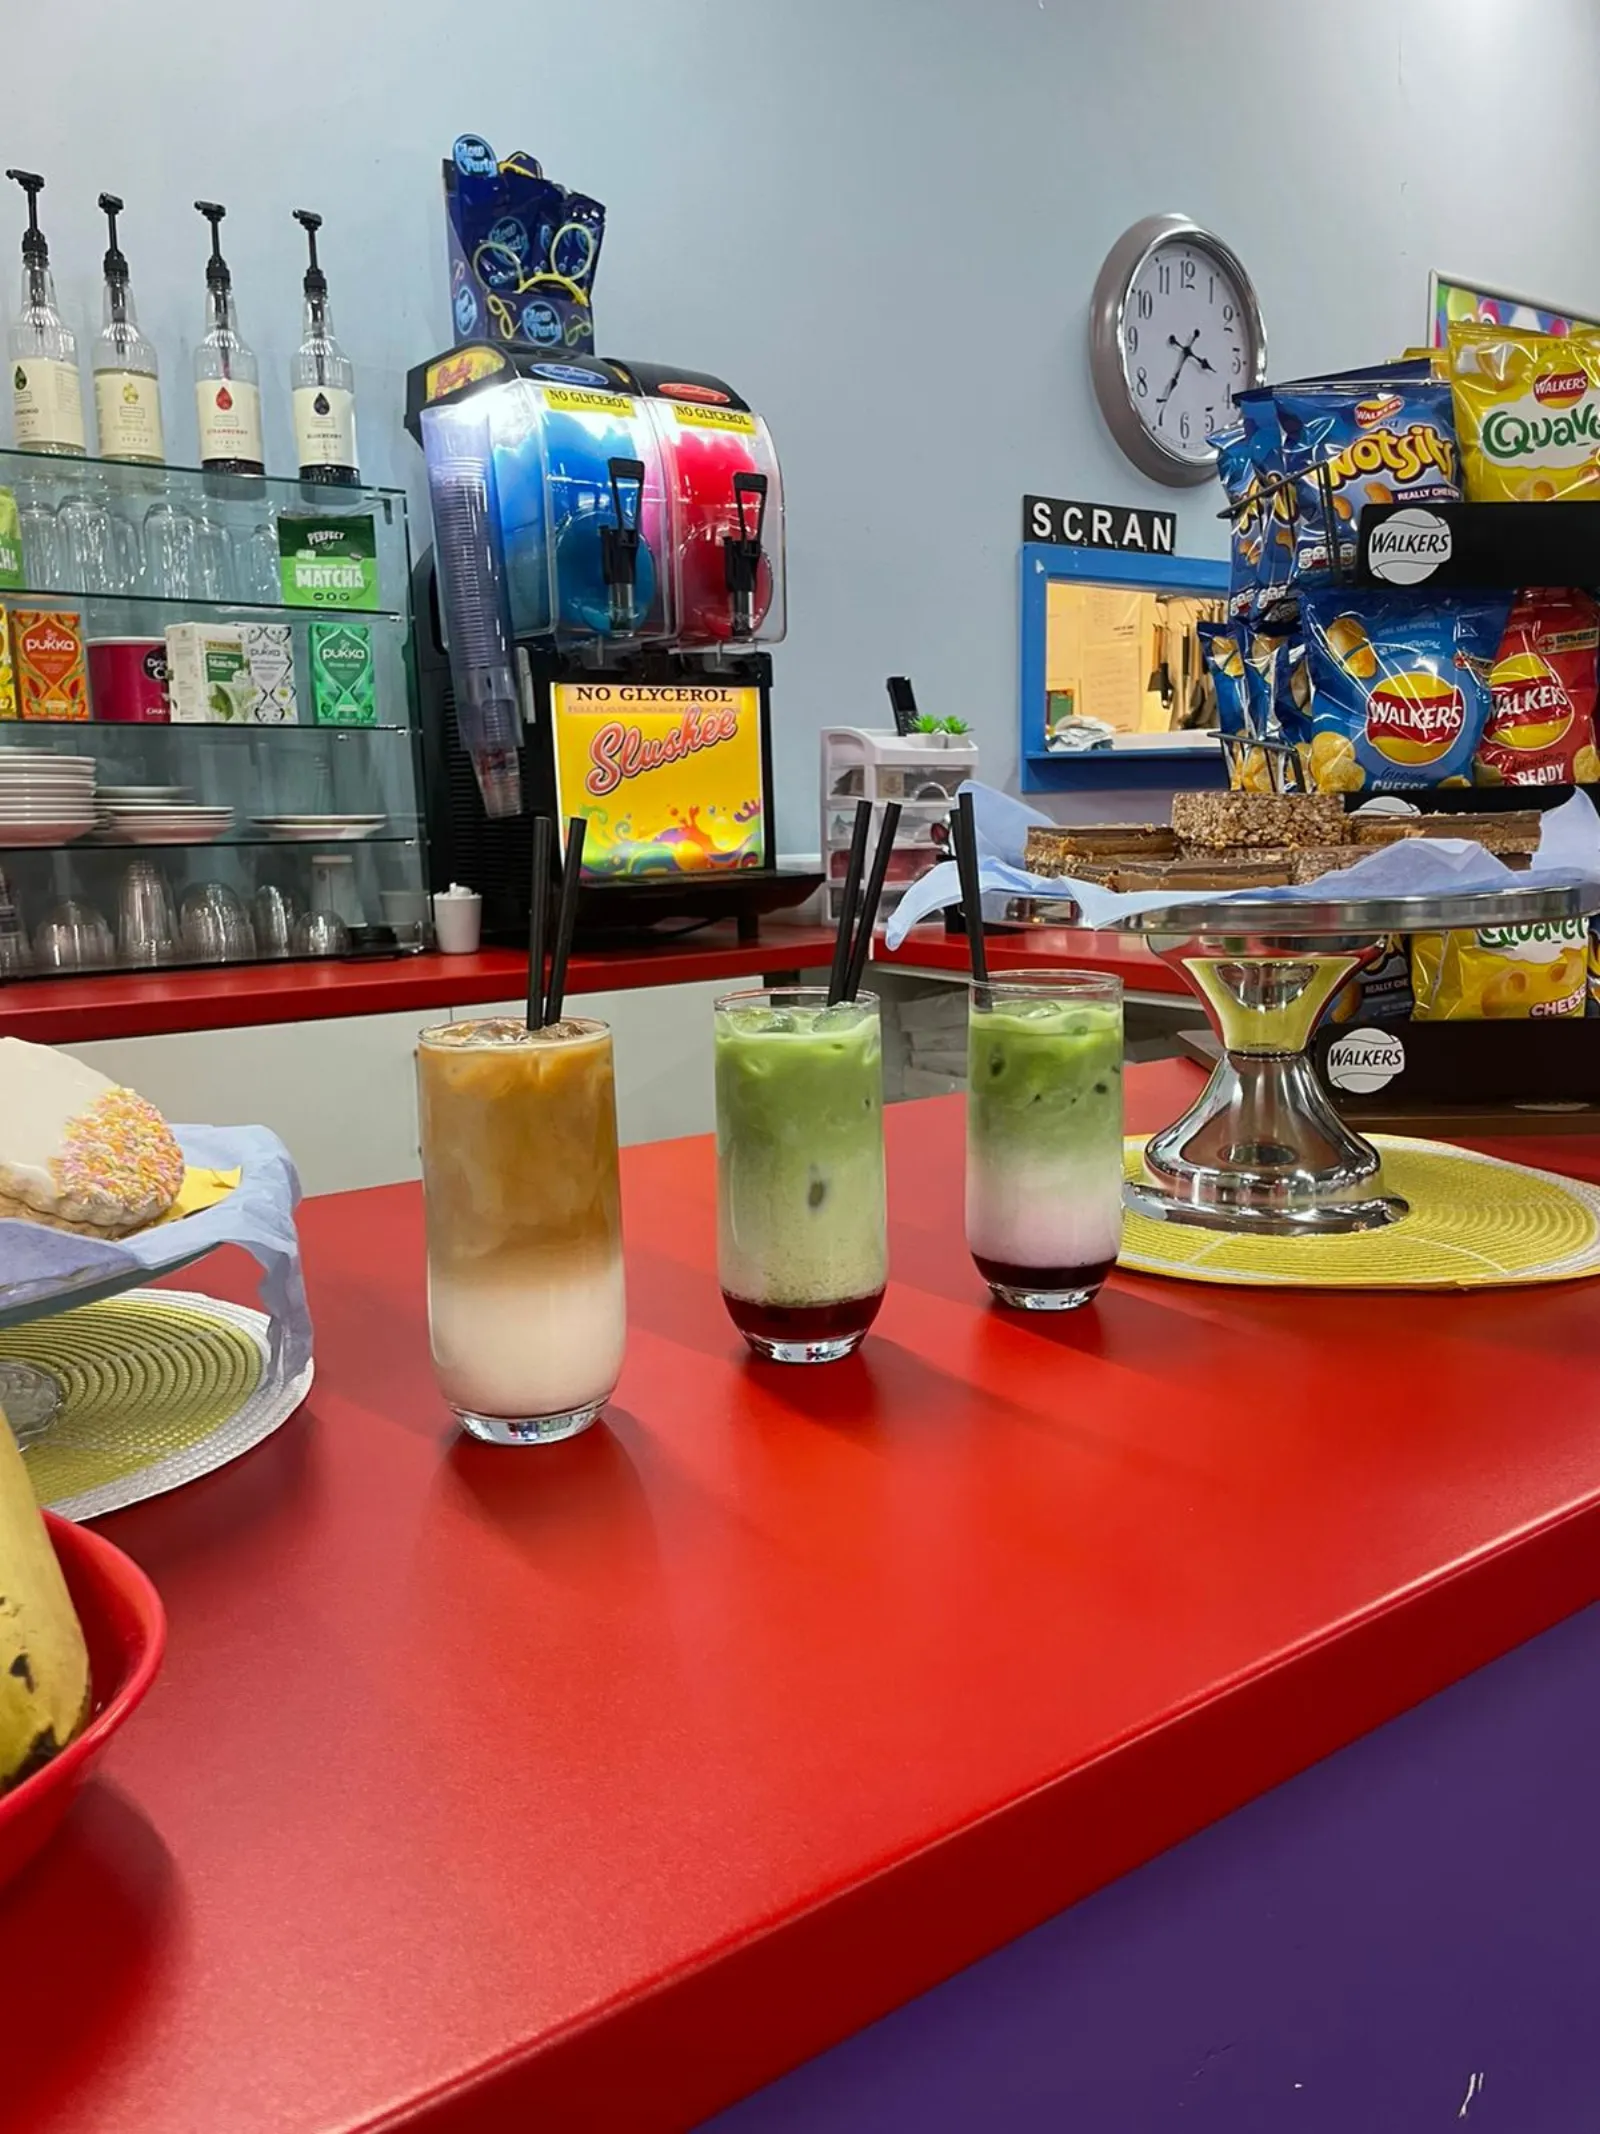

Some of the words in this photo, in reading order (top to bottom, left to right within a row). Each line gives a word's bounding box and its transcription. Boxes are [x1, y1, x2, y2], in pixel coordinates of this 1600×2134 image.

[455, 141, 487, 158] Glow
[464, 158, 499, 177] Party
[1158, 265, 1171, 294] 11
[1180, 260, 1196, 290] 12
[1208, 276, 1214, 304] 1
[1137, 290, 1153, 320] 10
[1222, 306, 1234, 332] 2
[1127, 326, 1139, 355] 9
[1231, 347, 1241, 374] 3
[1136, 367, 1149, 397] 8
[1534, 375, 1587, 395] WALKERS
[549, 389, 569, 402] NO
[569, 389, 630, 410] GLYCEROL
[675, 405, 693, 417] NO
[695, 406, 750, 426] GLYCEROL
[1179, 412, 1190, 439] 6
[1204, 406, 1215, 432] 5
[1032, 502, 1172, 551] SCRAN
[1371, 531, 1449, 554] WALKERS
[296, 569, 365, 589] MATCHA
[26, 638, 74, 651] pukka
[322, 648, 365, 660] pukka
[577, 686, 611, 701] NO
[619, 687, 733, 703] GLYCEROL
[1368, 699, 1462, 732] WALKERS
[586, 704, 738, 797] Slushee
[1516, 763, 1565, 786] READY
[1329, 1048, 1402, 1067] WALKERS
